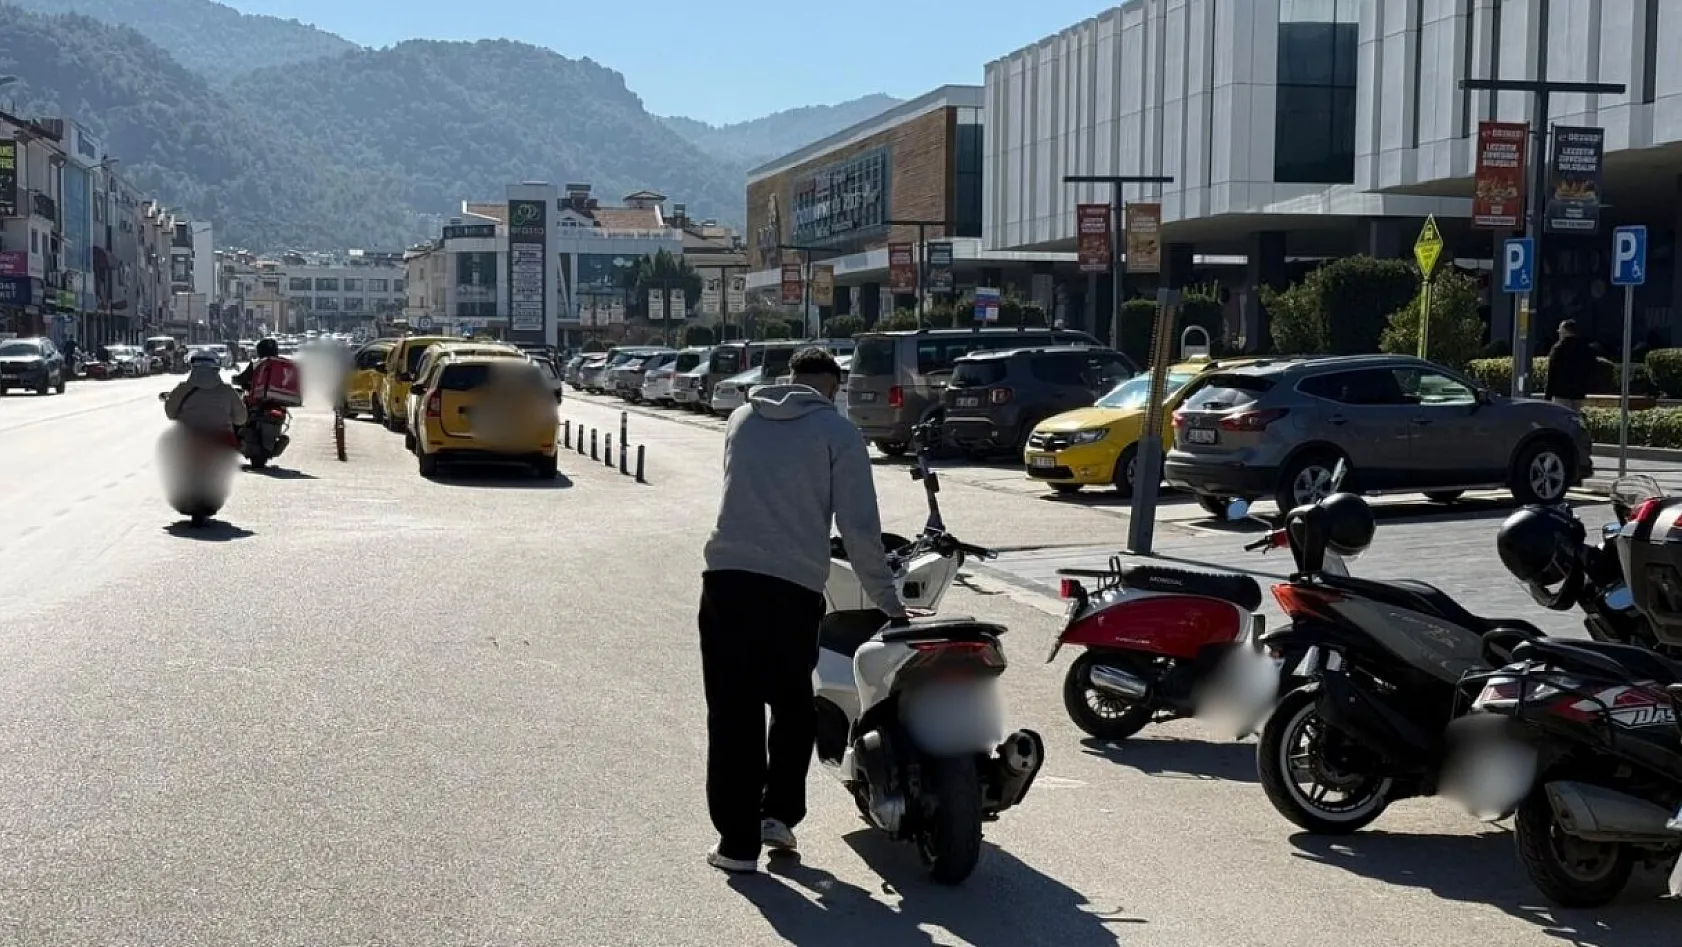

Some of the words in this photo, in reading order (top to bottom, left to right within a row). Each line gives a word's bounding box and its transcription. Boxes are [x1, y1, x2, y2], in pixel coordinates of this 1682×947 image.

[1506, 243, 1524, 286] P
[1615, 231, 1637, 277] P
[1149, 576, 1183, 586] MONDIAL
